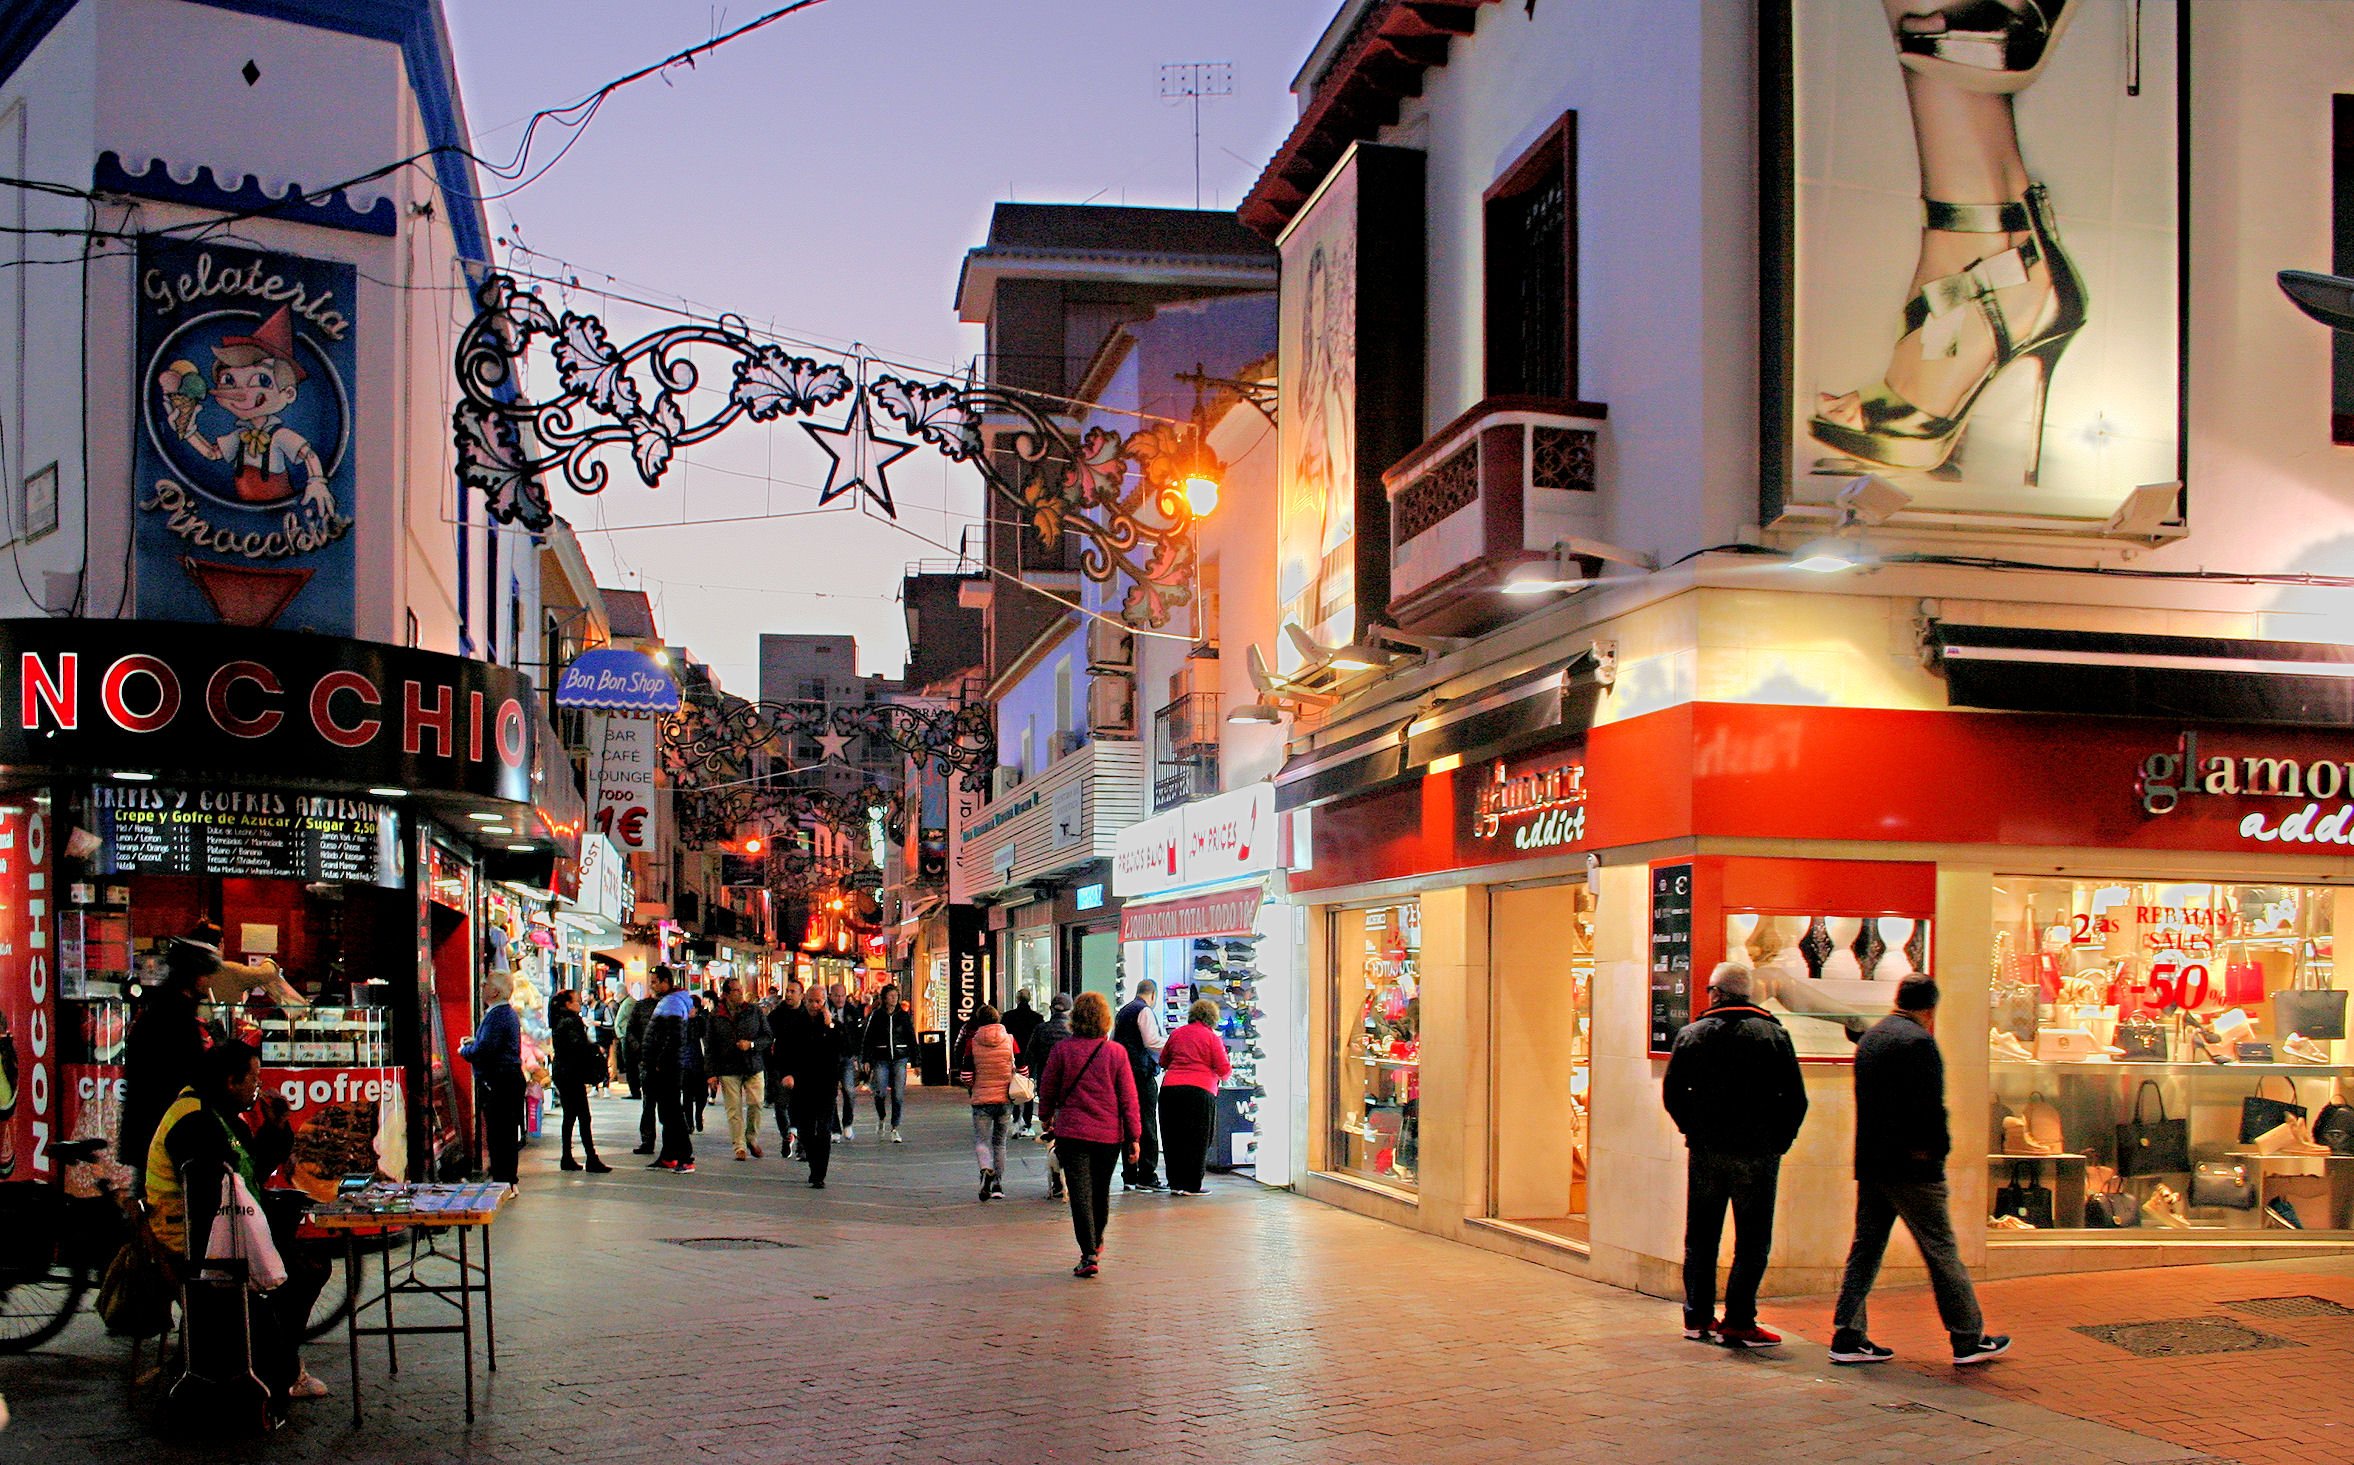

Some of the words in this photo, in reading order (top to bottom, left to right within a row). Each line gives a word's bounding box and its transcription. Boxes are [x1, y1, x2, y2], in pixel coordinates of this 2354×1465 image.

[144, 253, 349, 341] Gelateria
[566, 667, 594, 690] Bon
[597, 669, 627, 692] Bon
[627, 671, 665, 698] Shop
[606, 730, 636, 742] BAR
[601, 749, 641, 763] CAFÉ
[589, 771, 652, 784] LOUNGE
[199, 790, 286, 815] GOFRES
[599, 789, 634, 801] TODO
[115, 809, 155, 823] Crepe
[158, 811, 168, 825] y
[171, 809, 213, 823] Gofre
[217, 813, 236, 825] de
[240, 814, 291, 828] Azucar
[305, 817, 345, 833] Sugar
[1514, 806, 1586, 850] addict
[2239, 803, 2354, 845] add
[1208, 820, 1237, 854] PRICES
[579, 841, 601, 875] COST
[1178, 906, 1210, 935] TOTAL
[1209, 902, 1237, 932] TODO
[2145, 932, 2215, 951] SALES
[957, 951, 975, 1022] flormar
[78, 1074, 128, 1102] cre
[280, 1073, 394, 1111] gofres
